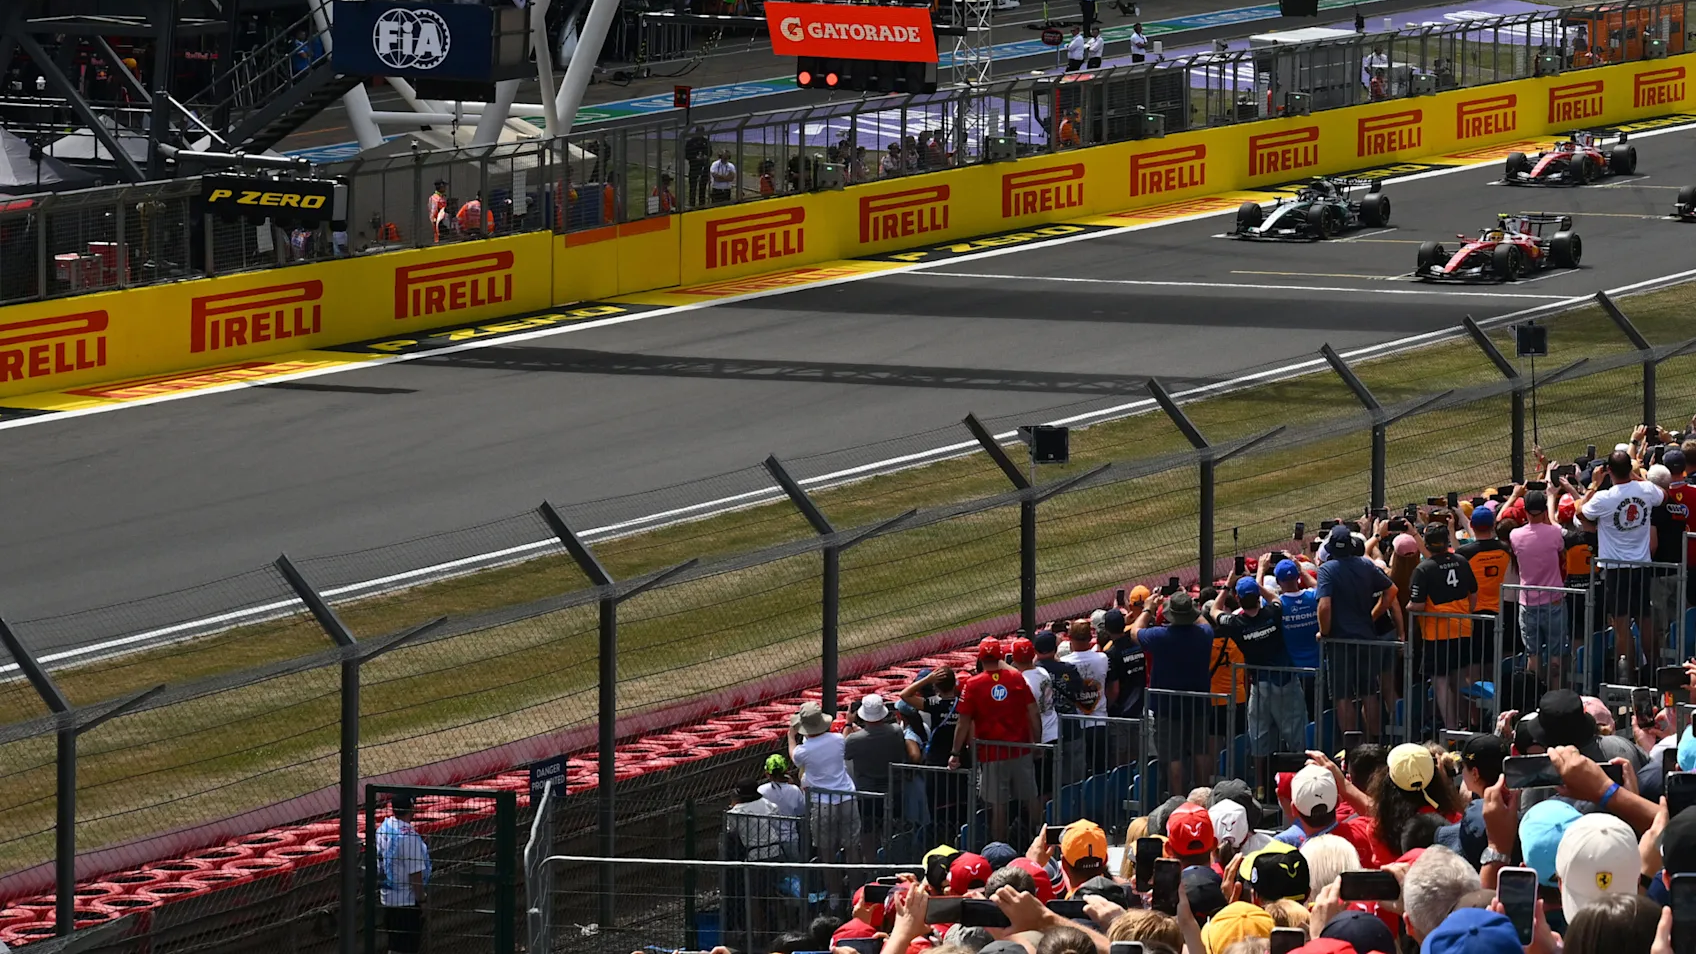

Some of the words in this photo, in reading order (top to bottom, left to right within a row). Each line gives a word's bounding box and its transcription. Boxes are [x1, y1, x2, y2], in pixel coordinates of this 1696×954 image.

[808, 23, 921, 43] GATORADE
[1549, 81, 1605, 124] PIRELLI
[1635, 68, 1687, 108] PIRELLI
[1359, 111, 1423, 158] PIRELLI
[1458, 94, 1517, 140] PIRELLI
[1131, 144, 1206, 196] PIRELLI
[1250, 126, 1319, 177] PIRELLI
[209, 190, 233, 203] P
[237, 191, 327, 209] ZERO
[1003, 164, 1085, 215] PIRELLI
[707, 207, 805, 268] PIRELLI
[861, 186, 951, 244] PIRELLI
[396, 252, 515, 320] PIRELLI
[191, 281, 324, 354] PIRELLI
[1446, 569, 1459, 587] 4
[536, 763, 561, 778] DANGER
